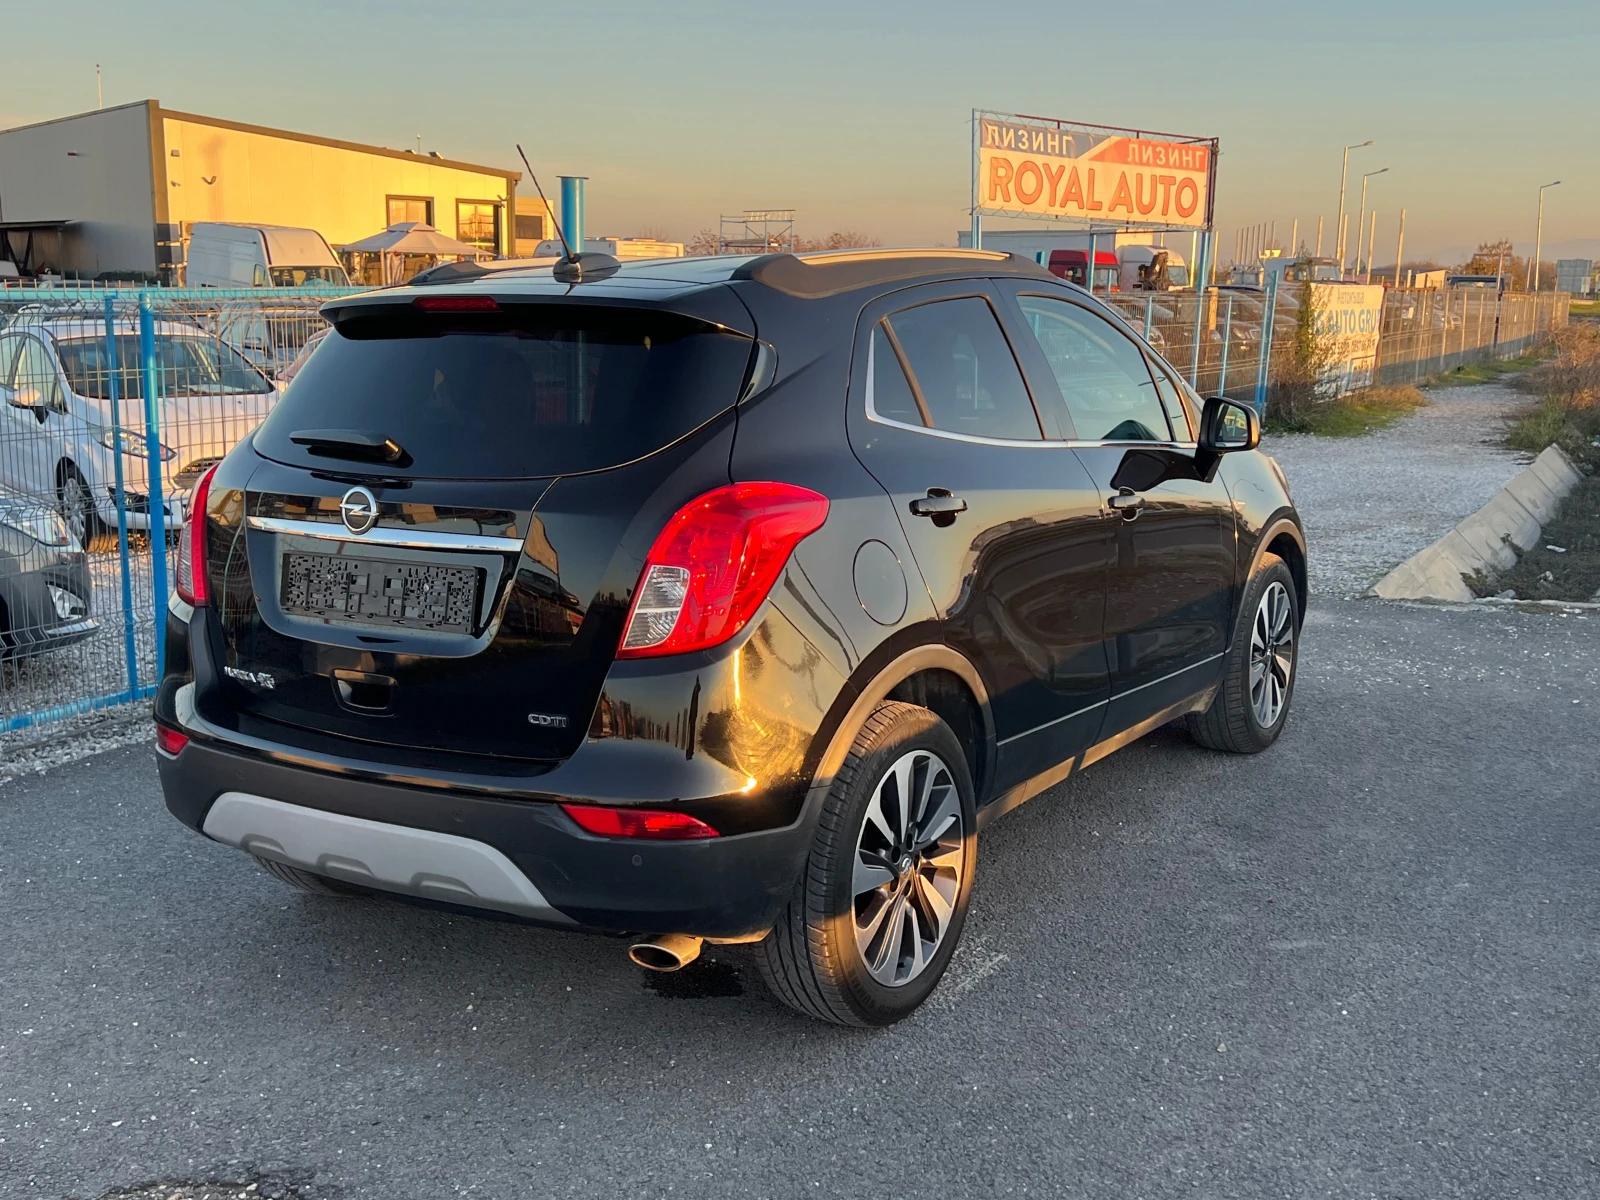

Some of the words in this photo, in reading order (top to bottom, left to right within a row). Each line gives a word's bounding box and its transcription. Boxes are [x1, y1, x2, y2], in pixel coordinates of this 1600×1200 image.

[985, 125, 1074, 155] ЛИЗИНГ
[1127, 143, 1204, 169] ЛИЗИНГ
[988, 157, 1103, 211] ROYAL
[1108, 171, 1199, 218] AUTO
[1328, 309, 1356, 335] AUTO
